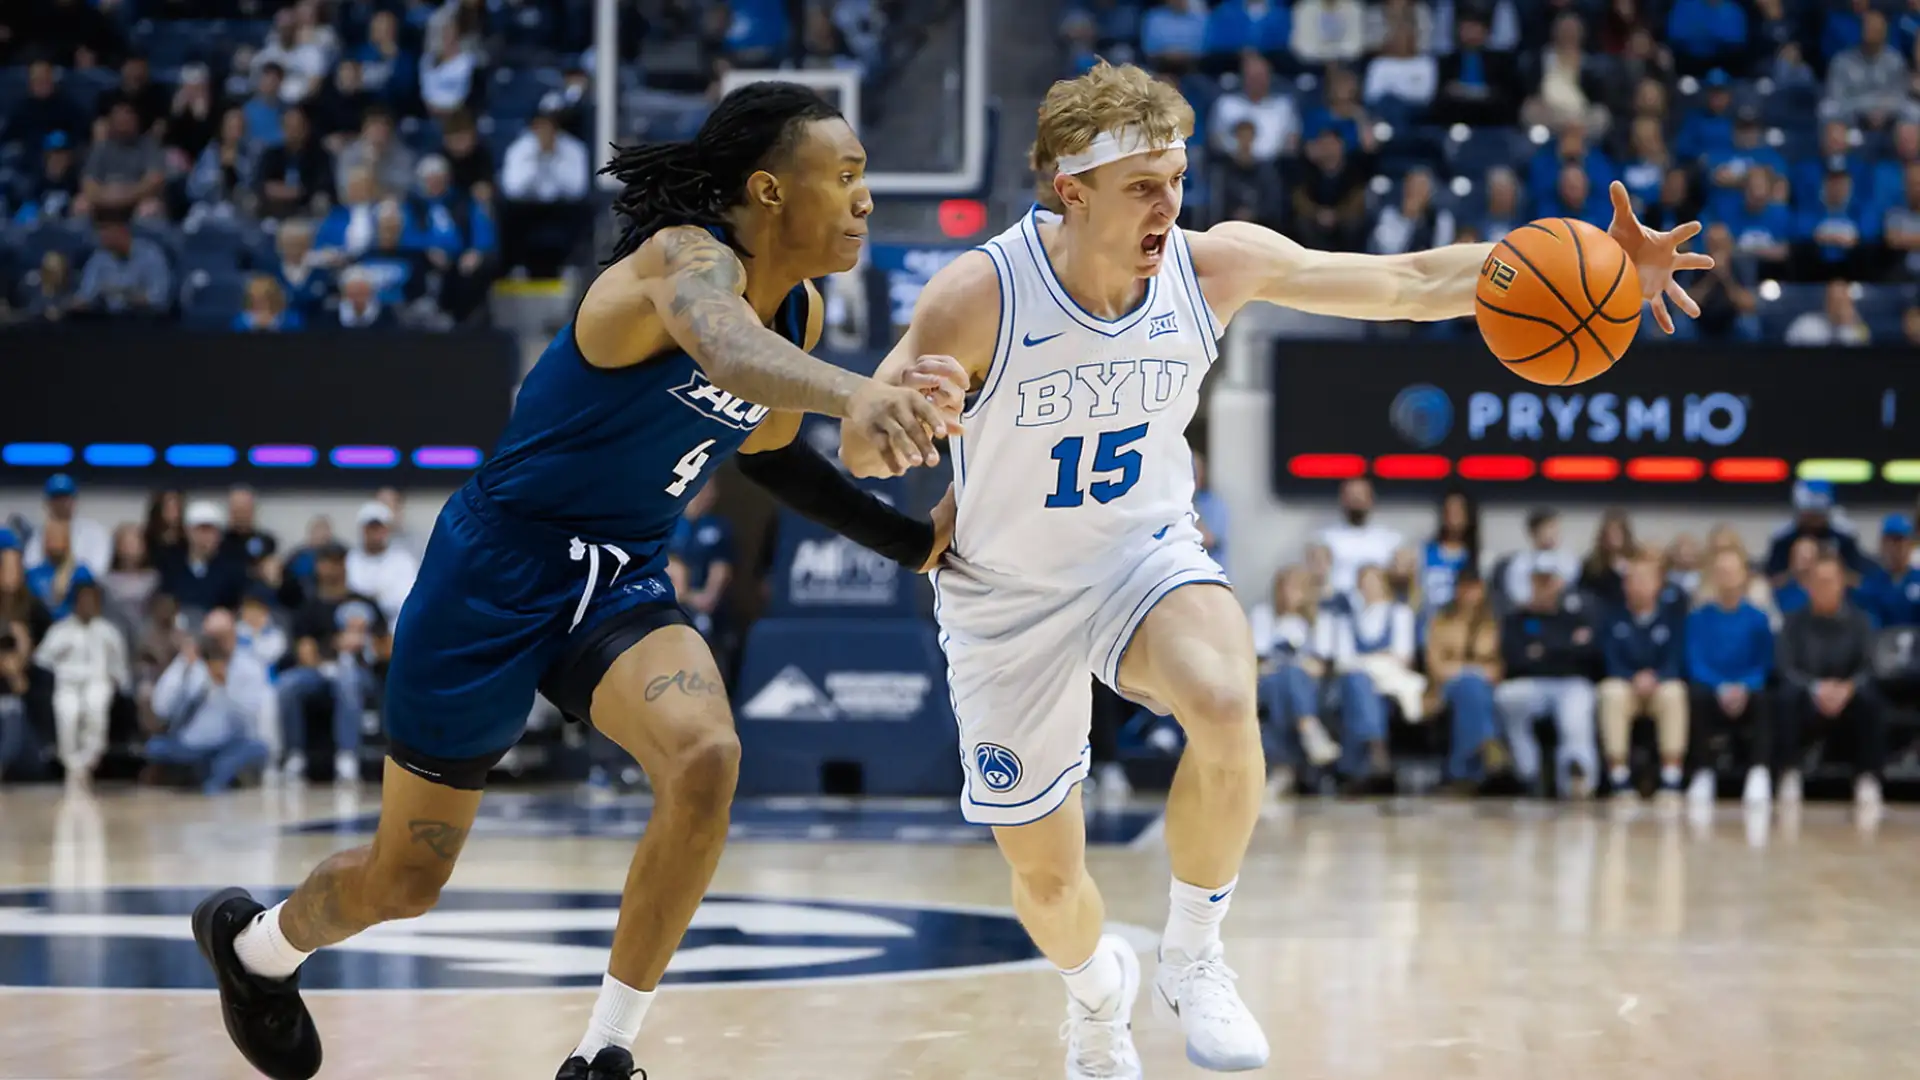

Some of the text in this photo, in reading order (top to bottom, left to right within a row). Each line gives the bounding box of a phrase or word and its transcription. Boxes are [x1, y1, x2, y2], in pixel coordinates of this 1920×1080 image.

[1015, 358, 1189, 427] BYU
[1468, 391, 1671, 442] PRYSM
[664, 438, 717, 498] 4
[1044, 422, 1149, 508] 15
[989, 772, 1004, 784] Y
